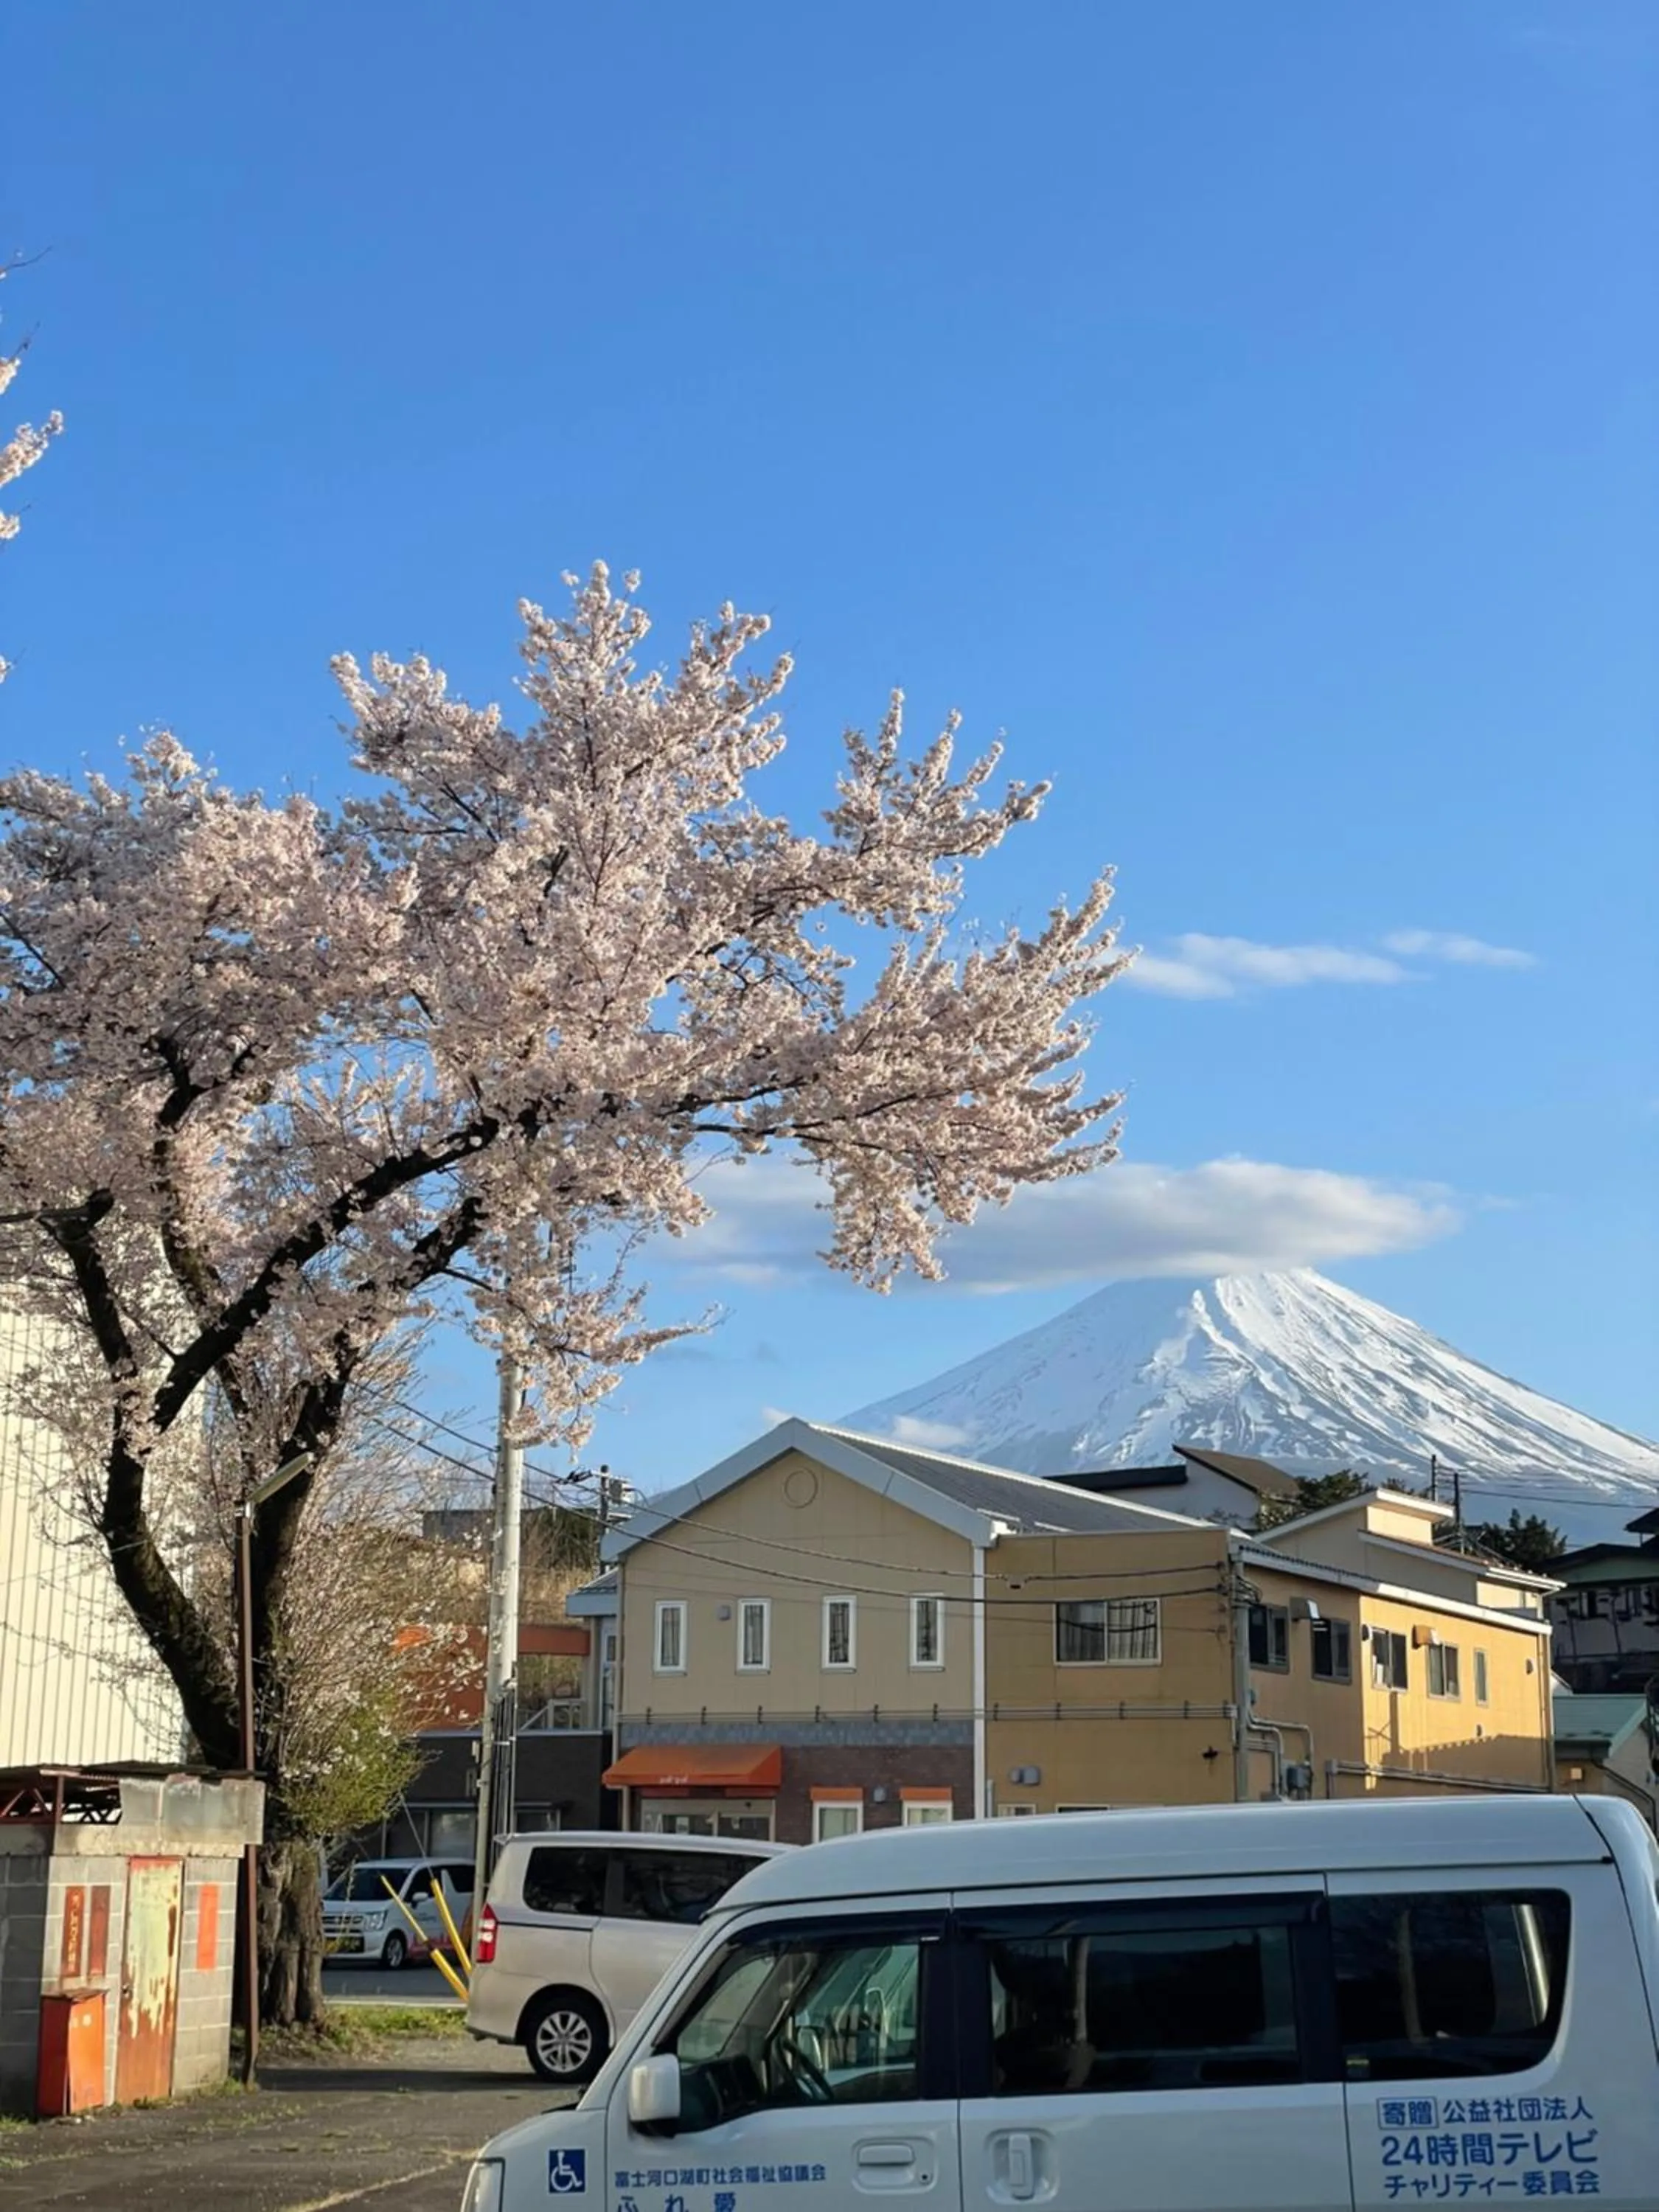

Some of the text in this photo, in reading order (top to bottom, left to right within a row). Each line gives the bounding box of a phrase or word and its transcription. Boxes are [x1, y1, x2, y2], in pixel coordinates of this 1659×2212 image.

[1382, 2096, 1593, 2126] 寄贈 公益社団法人
[1381, 2128, 1599, 2166] 24時間テレビ
[1384, 2170, 1600, 2199] チャリティー委員会
